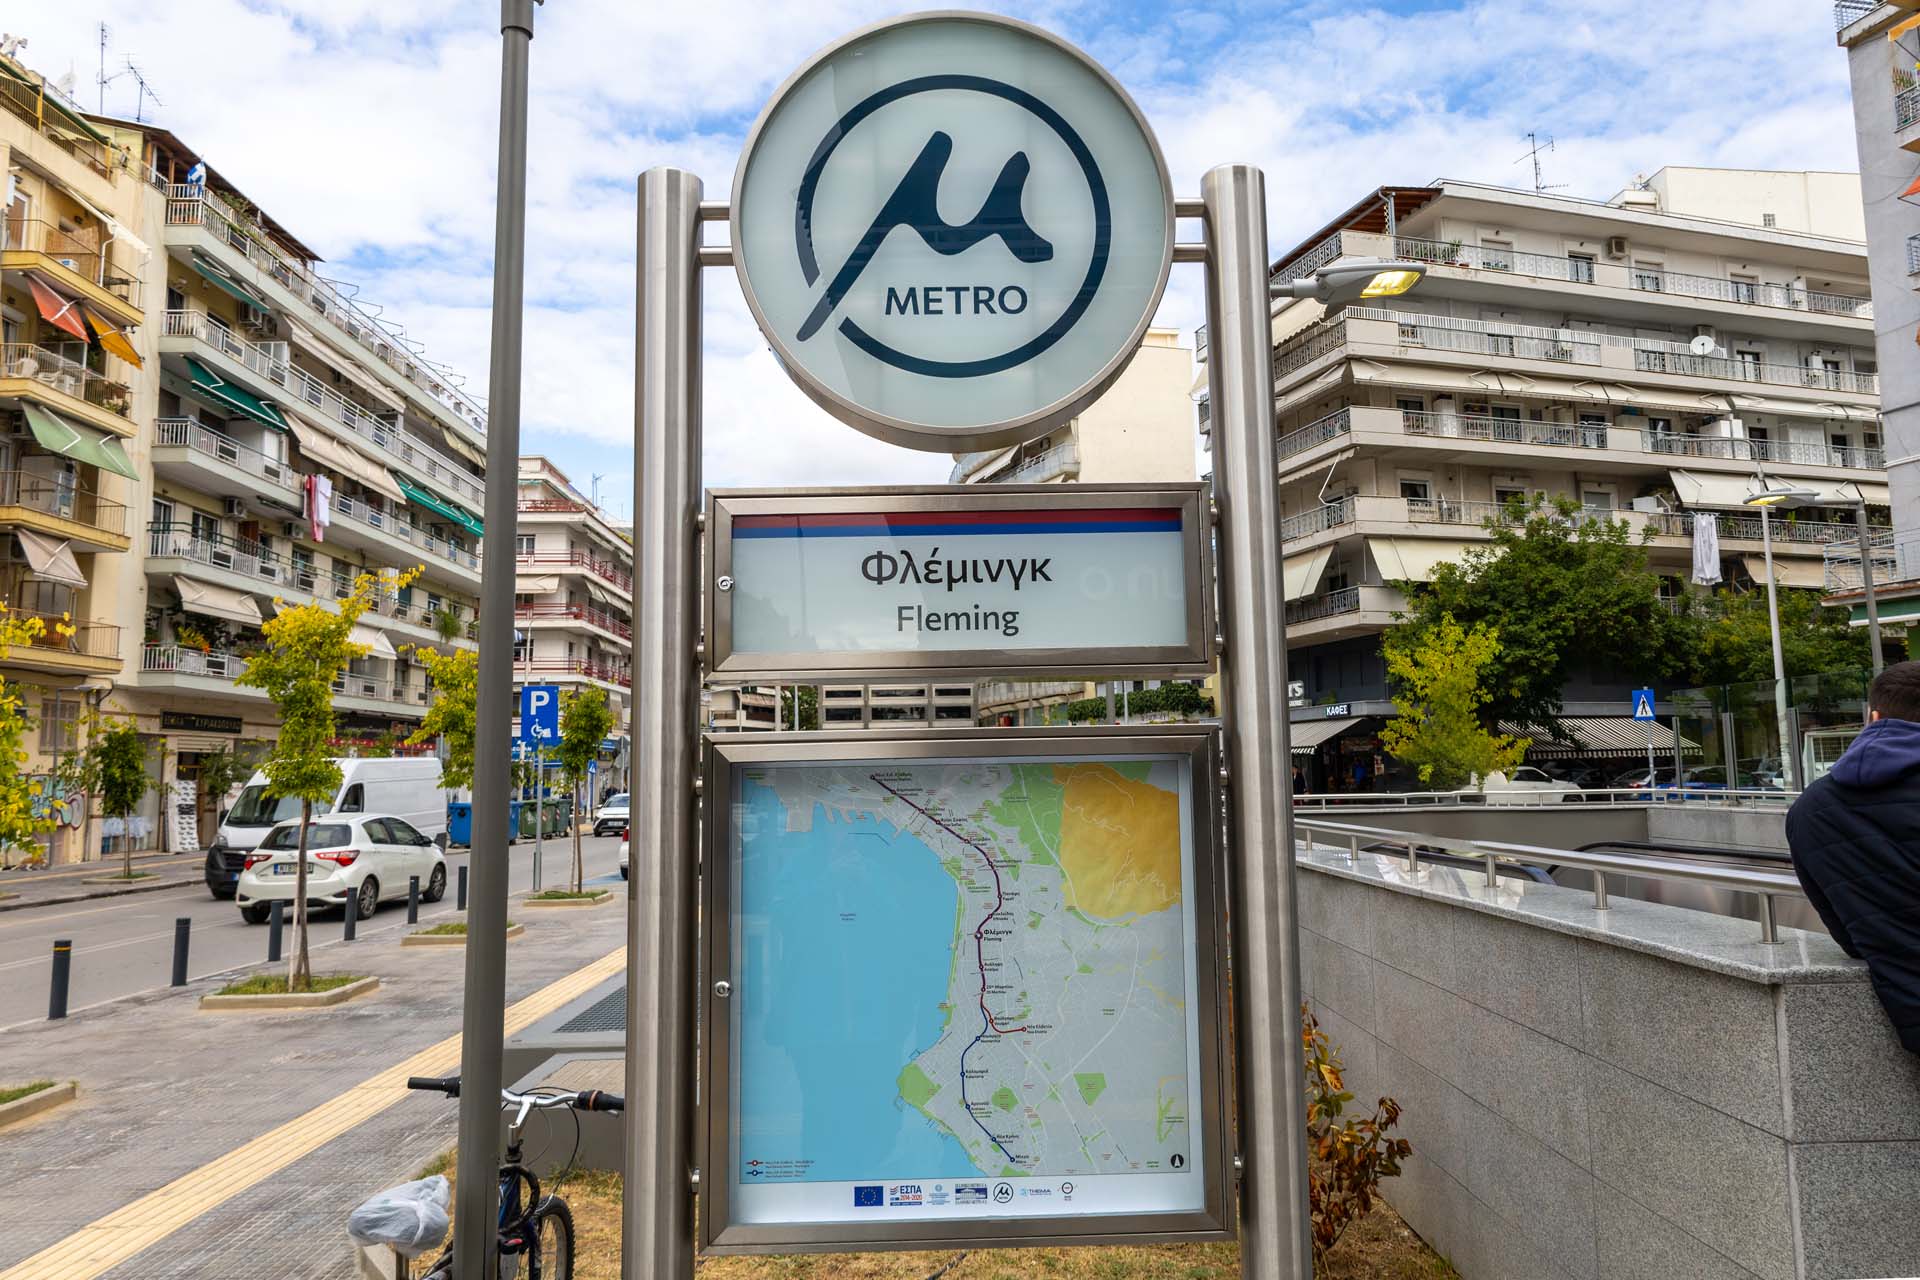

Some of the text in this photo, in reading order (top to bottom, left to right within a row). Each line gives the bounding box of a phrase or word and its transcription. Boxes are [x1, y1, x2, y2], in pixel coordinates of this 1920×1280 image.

[885, 285, 1029, 316] METRO
[861, 547, 1053, 592] Φλέμινγκ
[897, 604, 1020, 636] Fleming
[530, 691, 550, 715] P
[1326, 704, 1348, 716] ΚΑΦΕΣ
[900, 1185, 922, 1194] ΕΣΠΑ
